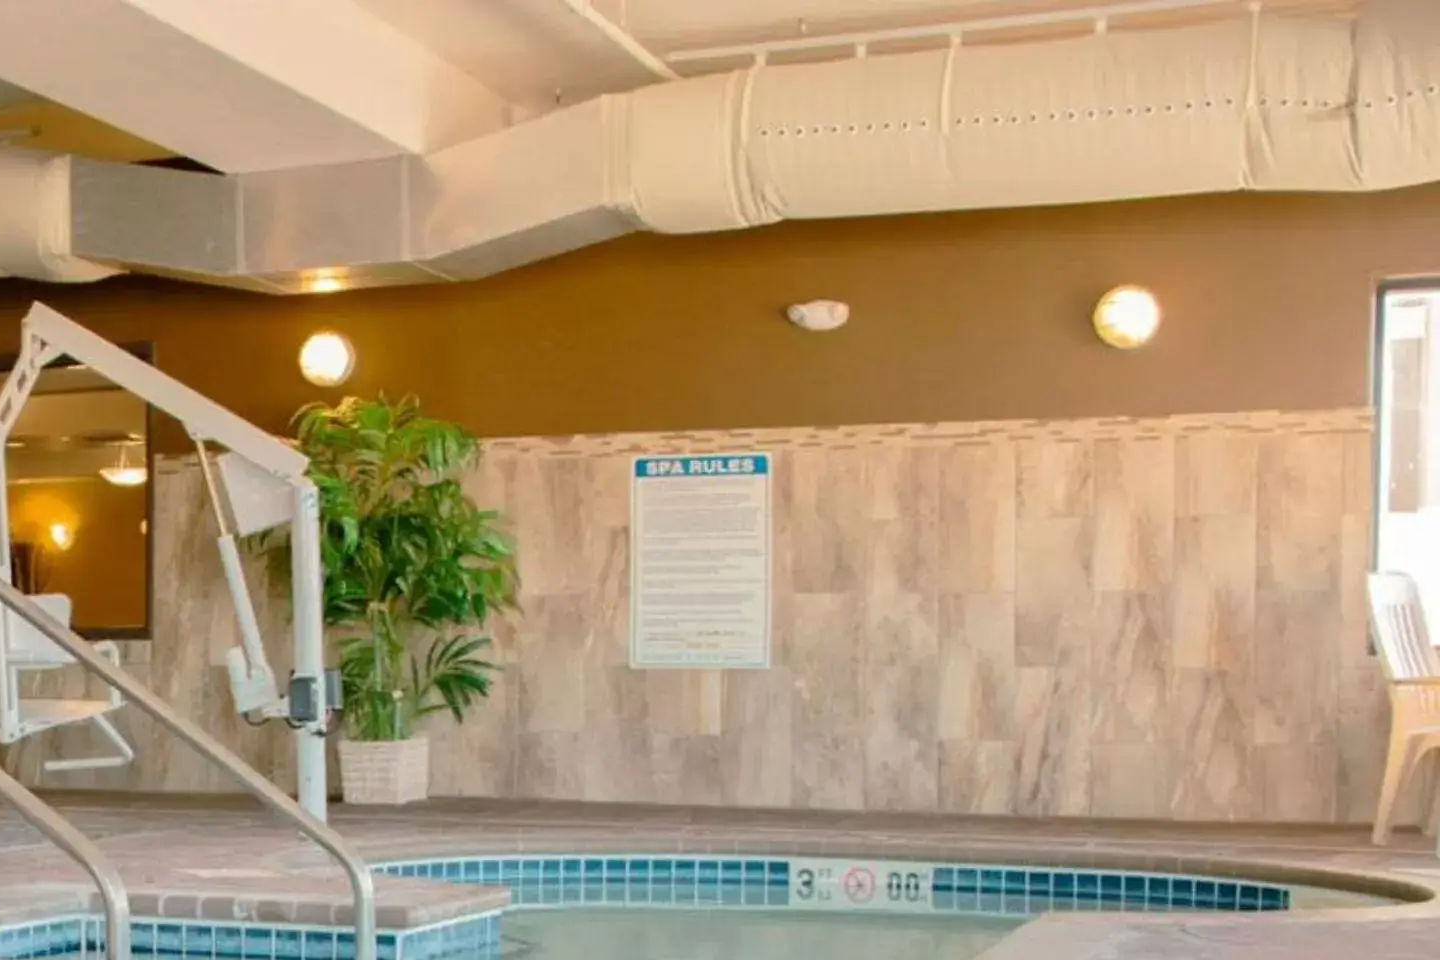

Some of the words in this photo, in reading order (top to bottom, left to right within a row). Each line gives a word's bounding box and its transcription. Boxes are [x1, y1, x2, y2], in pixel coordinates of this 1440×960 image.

[646, 459, 684, 475] SPA
[689, 458, 754, 473] RULES
[796, 867, 814, 899] 3
